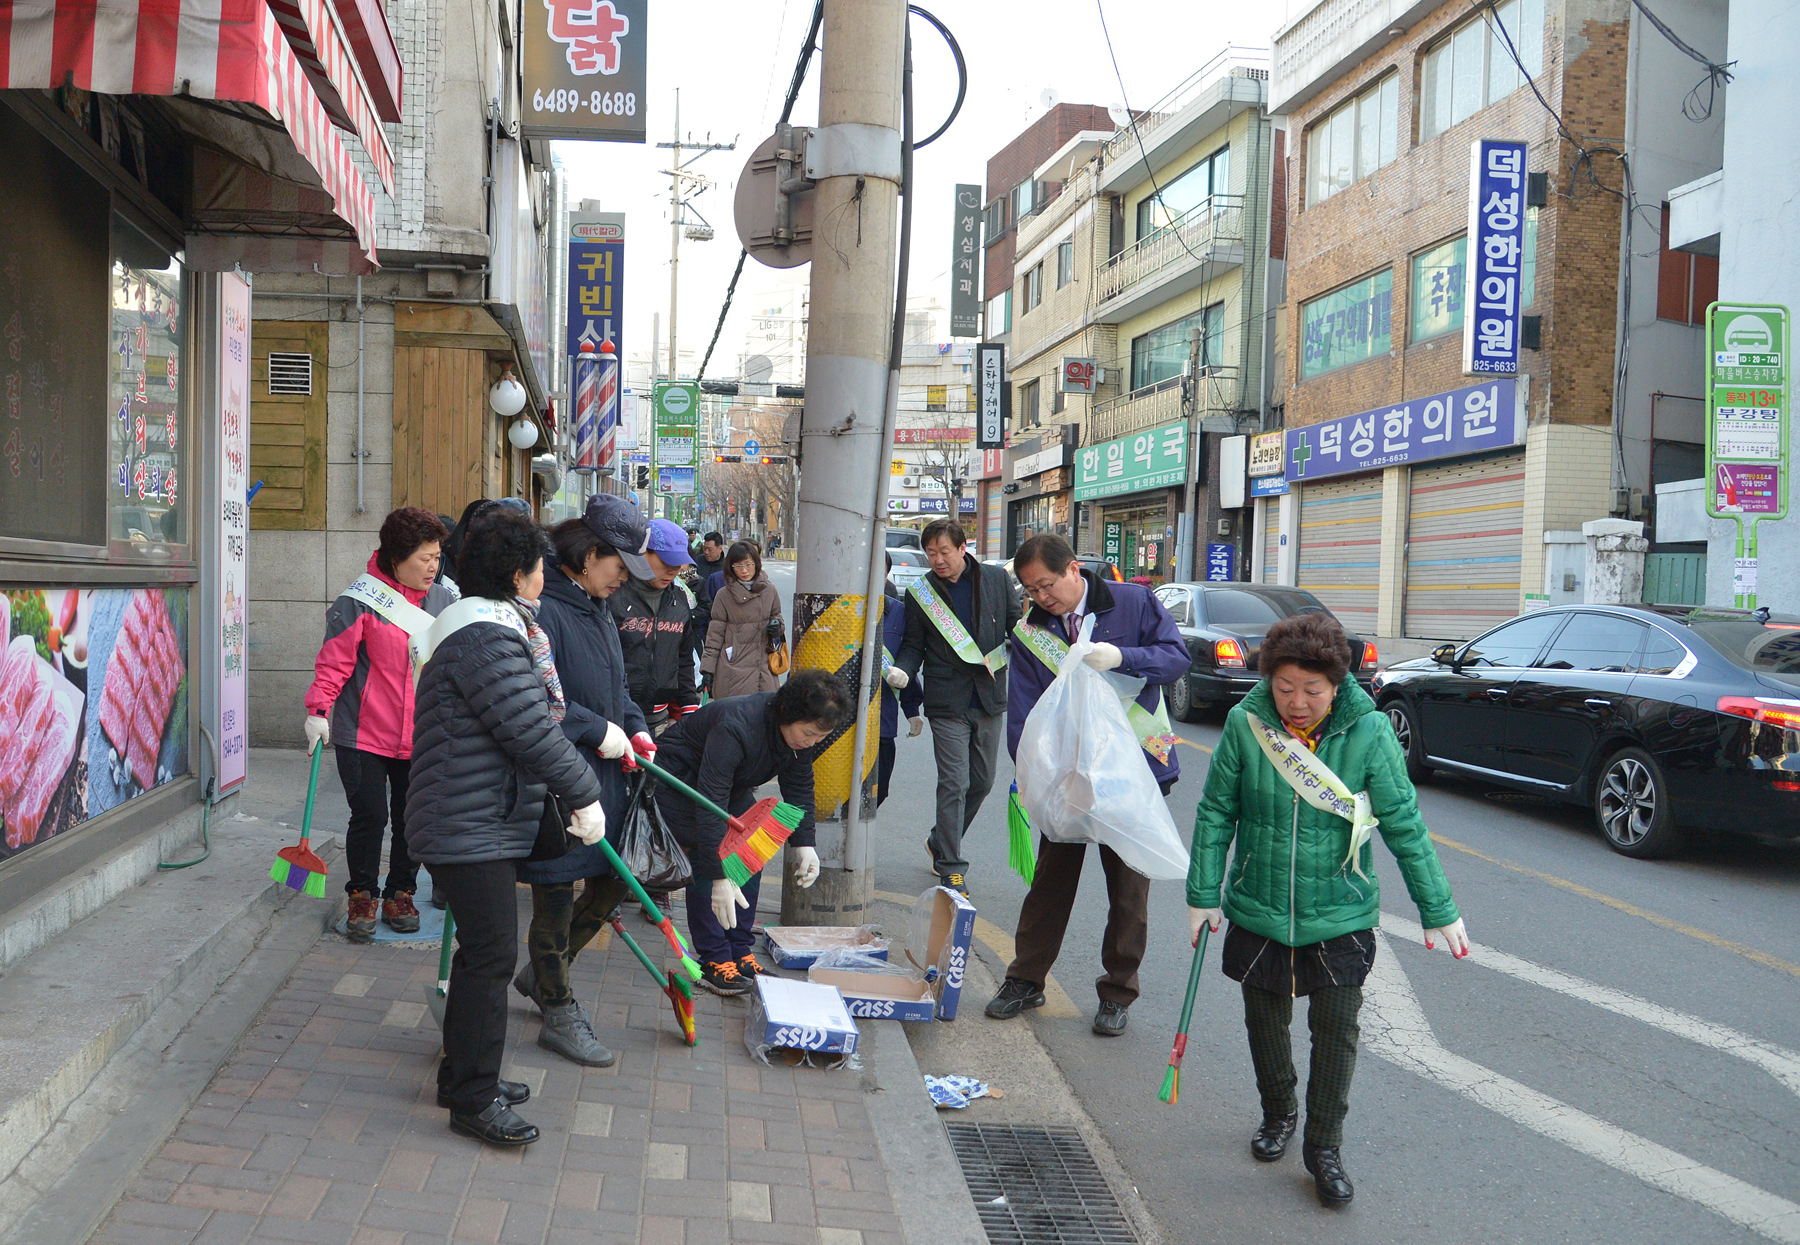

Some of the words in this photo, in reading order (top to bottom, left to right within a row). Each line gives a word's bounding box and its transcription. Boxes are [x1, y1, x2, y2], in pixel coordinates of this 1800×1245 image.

[543, 0, 629, 75] 닭
[533, 88, 636, 116] 6489-8688
[959, 215, 974, 295] 성심치과
[1478, 149, 1521, 358] 덕성한의원
[1431, 263, 1467, 317] 추진
[759, 320, 772, 331] LIG
[765, 333, 777, 341] 101
[1066, 361, 1095, 391] 약
[1473, 360, 1517, 373] 825-6633
[1717, 367, 1779, 381] 마을버스승차장
[1726, 392, 1747, 404] 동작
[1319, 385, 1498, 463] 덕성한의원
[1718, 408, 1778, 420] 부강탕
[987, 425, 996, 439] 9
[1082, 425, 1185, 483] 한일약국
[1252, 446, 1281, 465] 노래연습장
[1359, 452, 1409, 468] TEL:825-6633
[1283, 751, 1323, 790] 깨끗한
[946, 945, 966, 989] Cass
[848, 999, 896, 1018] Cass
[773, 1026, 828, 1051] Cass
